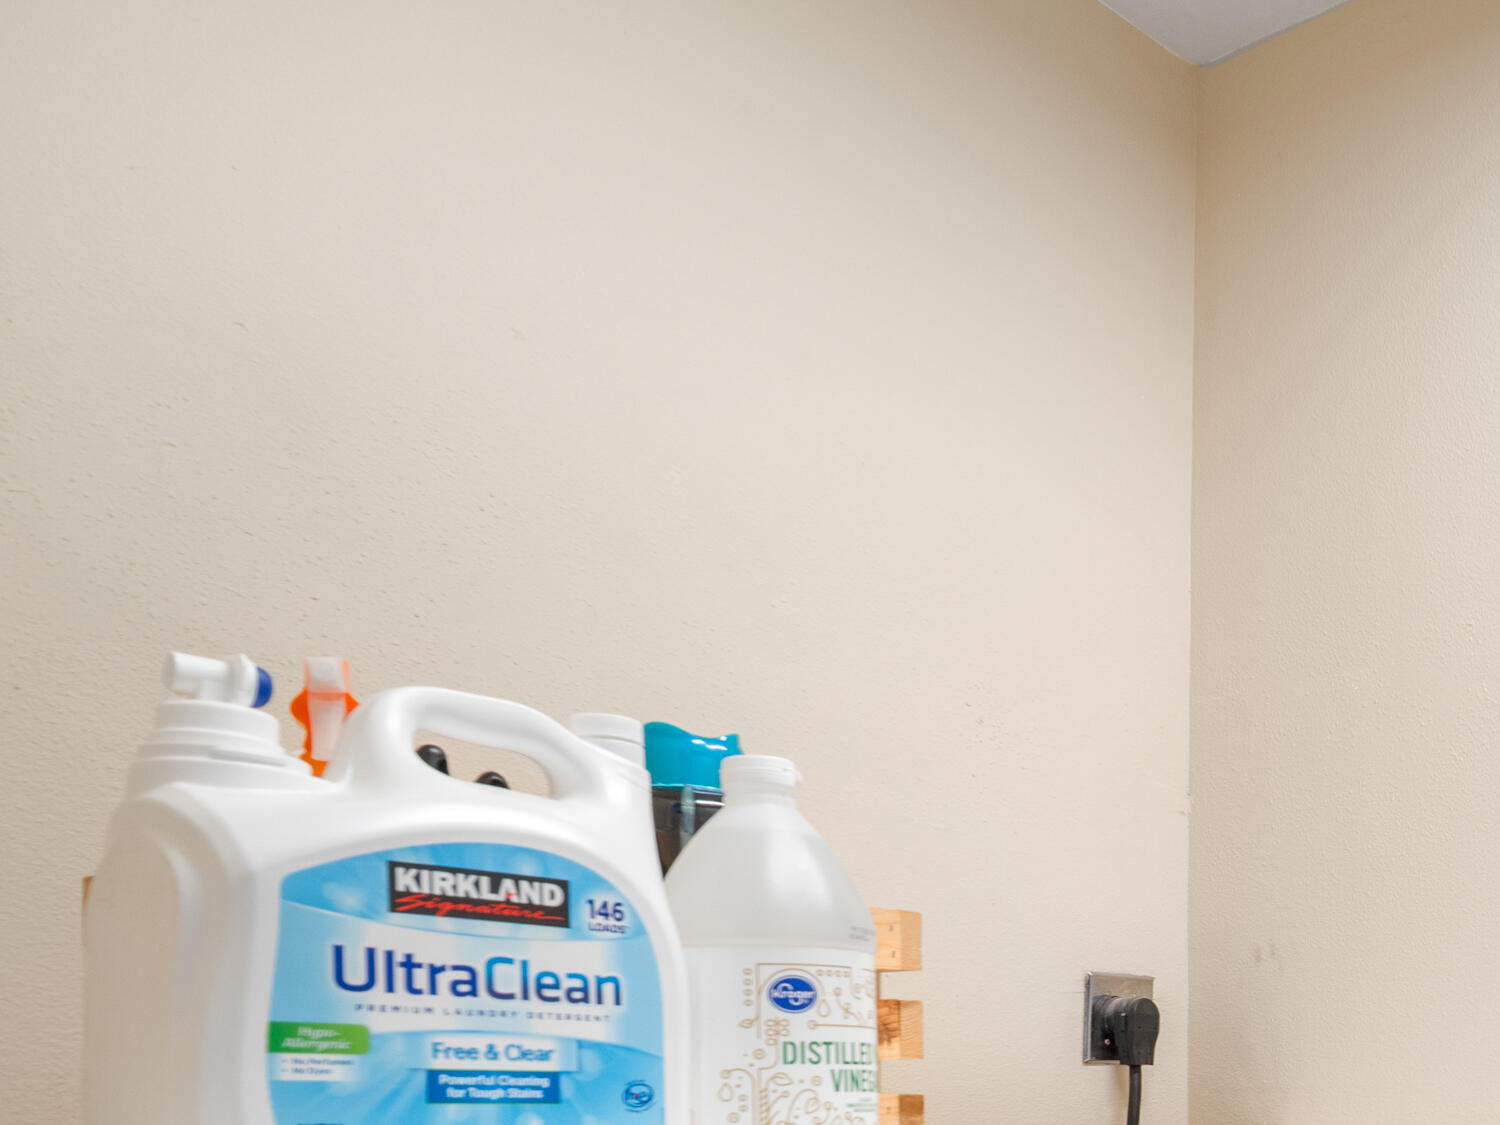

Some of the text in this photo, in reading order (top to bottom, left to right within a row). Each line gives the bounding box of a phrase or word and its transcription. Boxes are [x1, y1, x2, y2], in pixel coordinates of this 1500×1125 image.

[393, 866, 565, 908] KIRKLAND
[394, 890, 566, 922] Signature
[586, 898, 625, 923] 146
[331, 944, 623, 1007] UltraClean
[354, 1003, 612, 1022] PREMIUM LAUNDRY DETERGENT
[430, 1041, 555, 1063] Free & Clear
[438, 1074, 551, 1089] Powerful Cleaning
[446, 1087, 544, 1100] for Tough Stains
